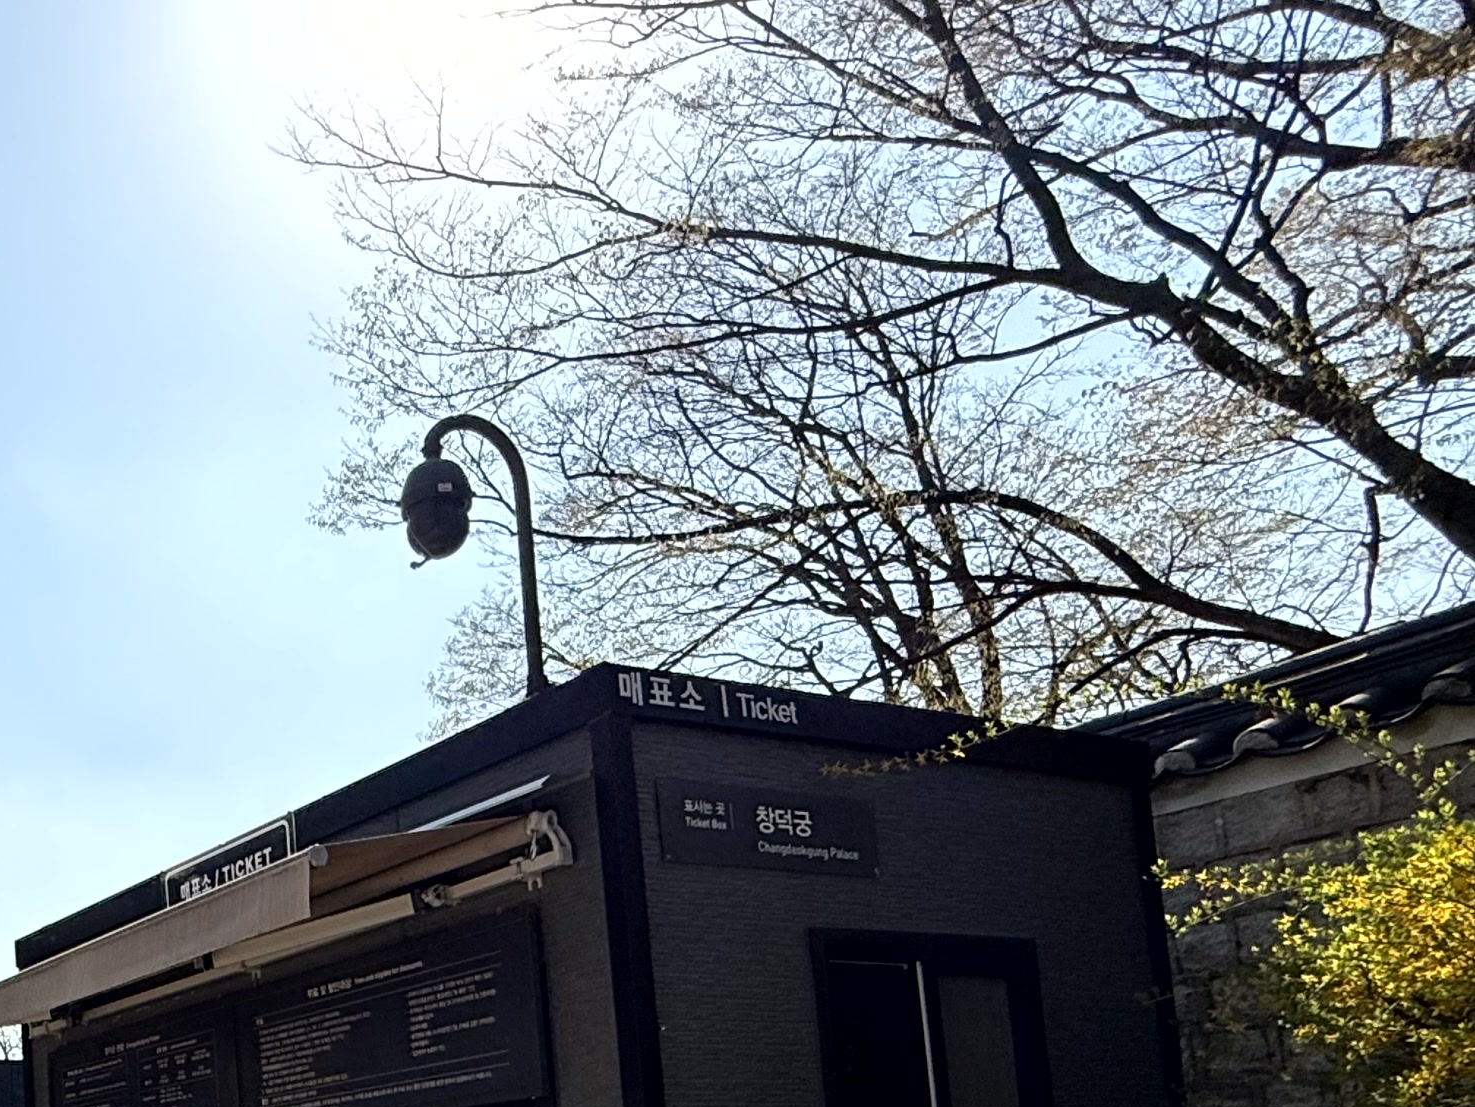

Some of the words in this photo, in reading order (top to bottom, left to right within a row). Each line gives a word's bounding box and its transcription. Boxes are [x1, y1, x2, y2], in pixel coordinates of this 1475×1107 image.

[618, 671, 706, 711] 매표소
[735, 692, 799, 725] Ticket
[715, 801, 726, 816] 곳
[685, 816, 711, 829] Ticket
[755, 805, 813, 838] 창덕궁
[829, 846, 859, 861] Palace
